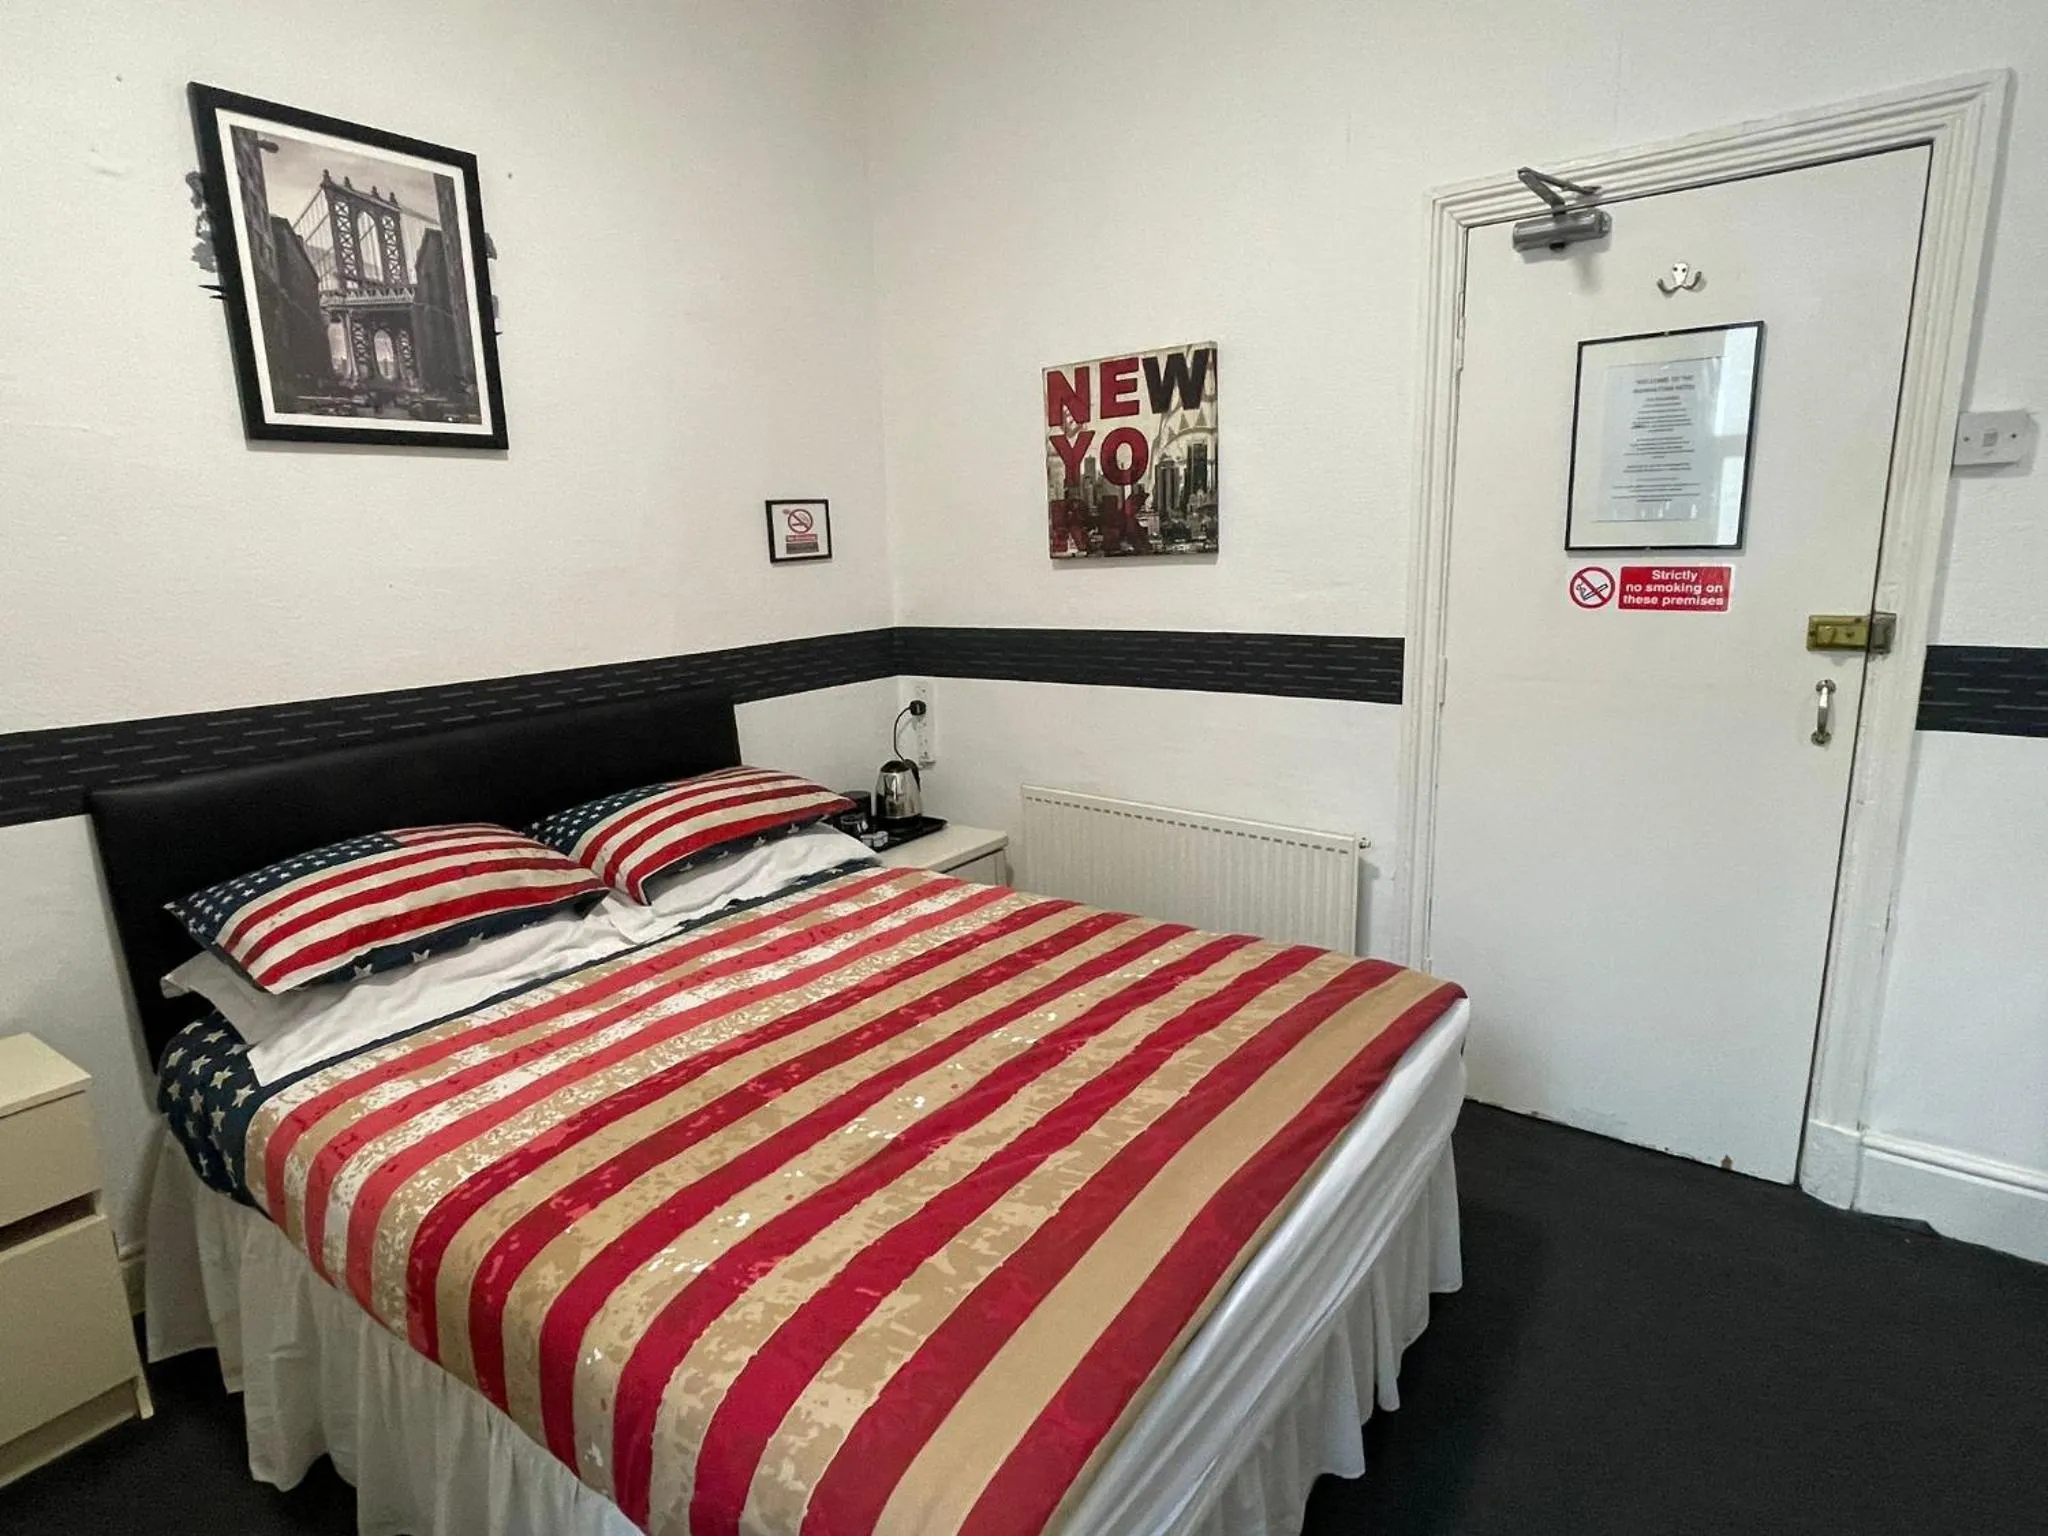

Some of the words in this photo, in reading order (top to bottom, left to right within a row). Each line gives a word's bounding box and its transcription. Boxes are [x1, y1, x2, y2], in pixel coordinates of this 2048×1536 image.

[1047, 349, 1209, 427] NEW
[1050, 427, 1149, 498] YO
[1652, 569, 1698, 582] Strictly
[1625, 583, 1643, 592] no
[1645, 583, 1702, 595] smoking
[1706, 584, 1724, 593] on
[1623, 594, 1659, 605] these
[1662, 595, 1724, 607] premises
